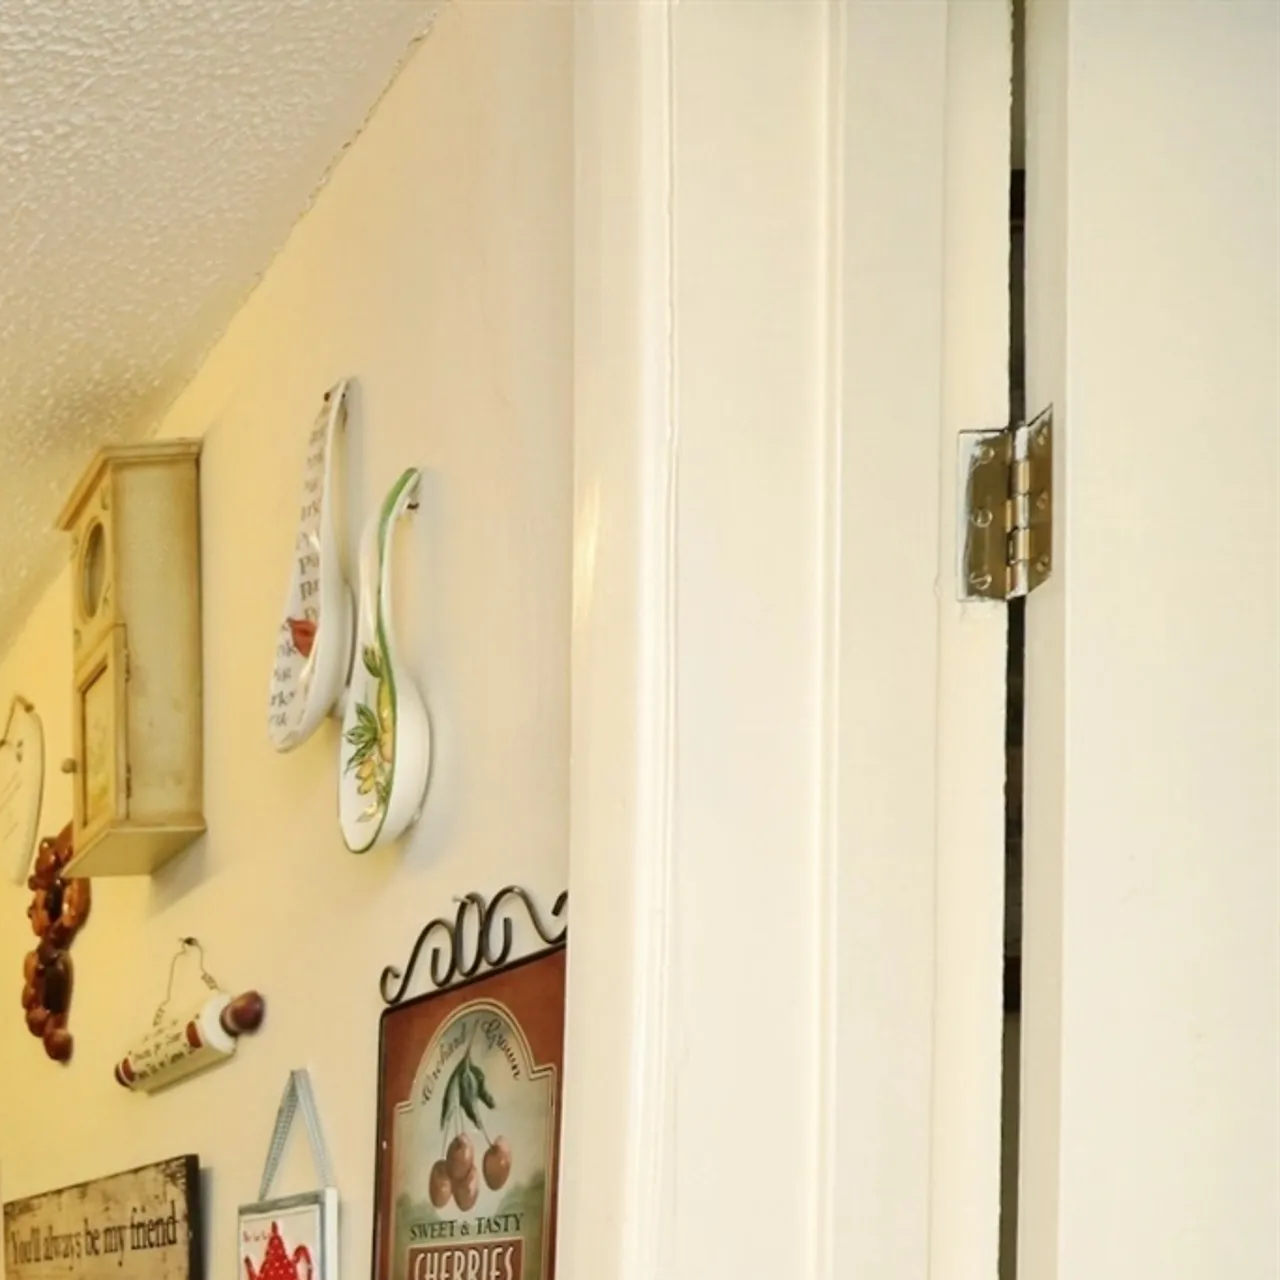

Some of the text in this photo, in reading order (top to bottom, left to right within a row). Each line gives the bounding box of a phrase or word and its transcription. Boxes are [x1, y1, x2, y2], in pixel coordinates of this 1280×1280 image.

[84, 1217, 100, 1256] be
[103, 1224, 126, 1267] my
[129, 1200, 179, 1251] friend
[410, 1213, 524, 1241] SWEET & TASTY
